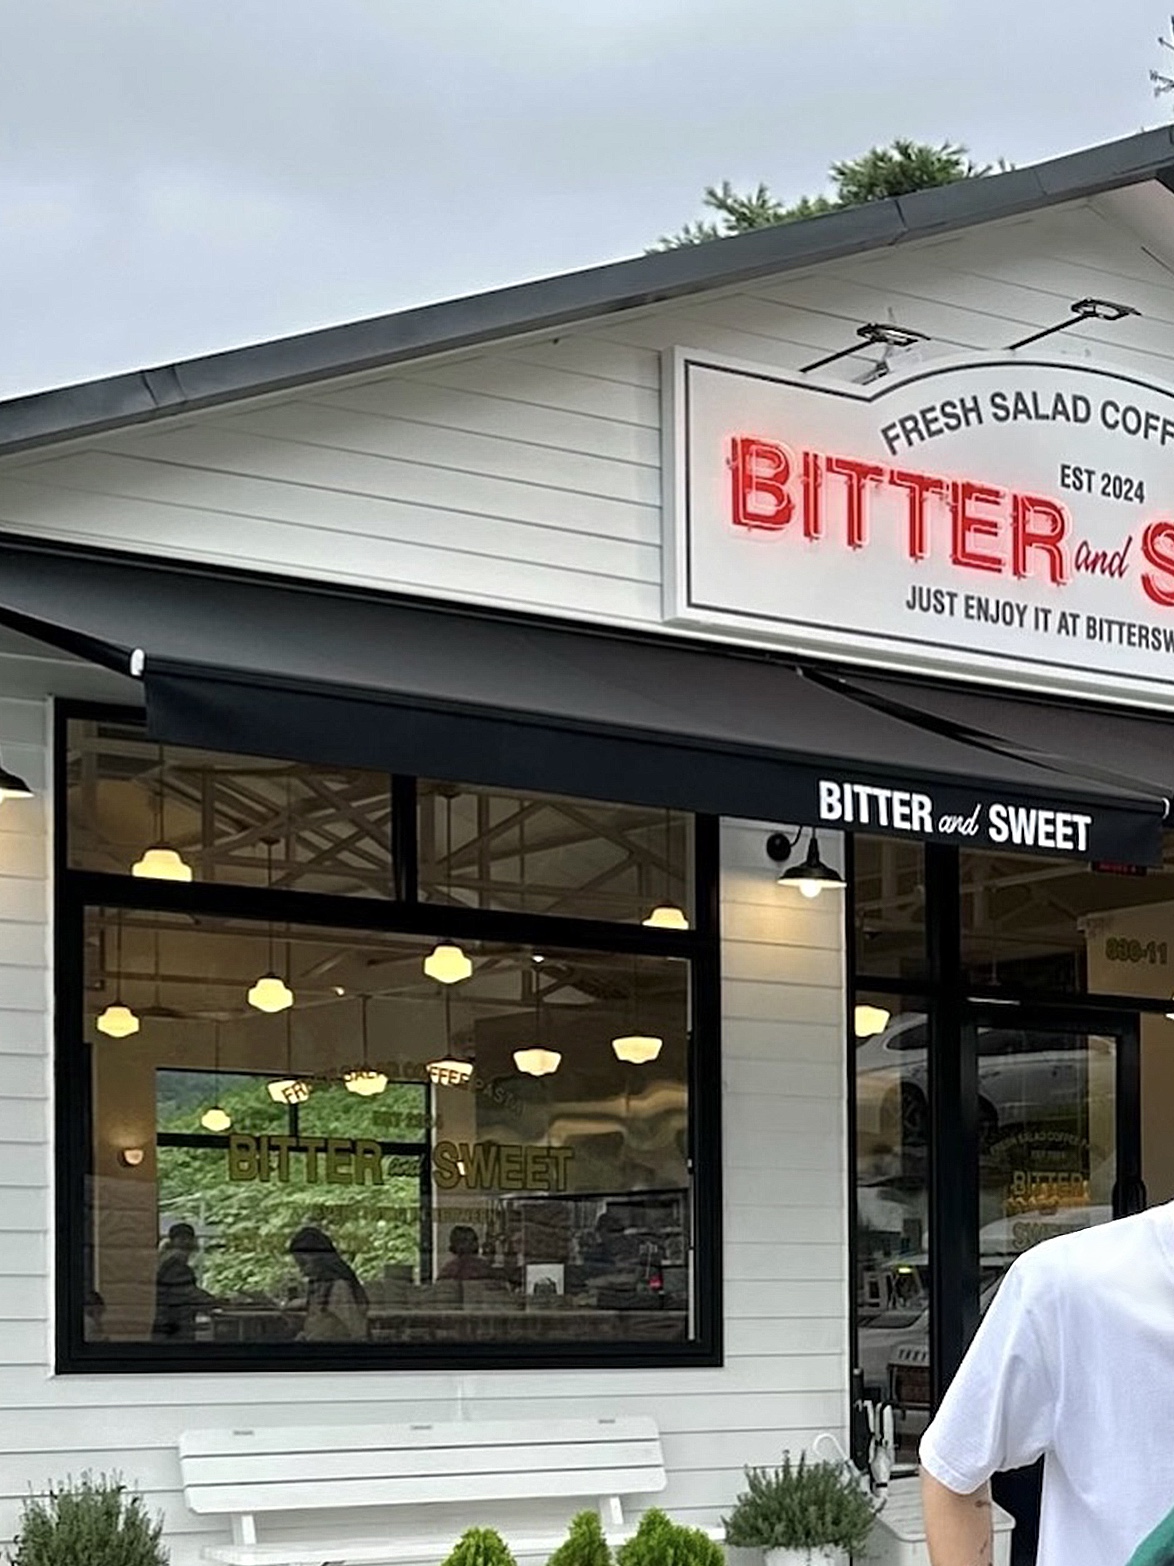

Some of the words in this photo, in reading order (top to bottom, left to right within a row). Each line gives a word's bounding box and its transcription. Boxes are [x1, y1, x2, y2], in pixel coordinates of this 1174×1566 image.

[881, 394, 985, 457] FRESH
[990, 392, 1091, 424] SALAD
[728, 436, 1071, 587] BITTER
[1074, 535, 1134, 580] and
[1060, 464, 1097, 490] EST
[1101, 469, 1146, 504] 2024
[905, 584, 957, 616] JUST
[964, 590, 1028, 628] ENJOY
[1033, 601, 1052, 632] IT
[1056, 605, 1080, 635] AT
[818, 779, 933, 834] BITTER
[938, 803, 981, 837] and
[988, 804, 1092, 852] SWEET
[228, 1133, 385, 1186] BITTER
[432, 1141, 574, 1193] SWEET
